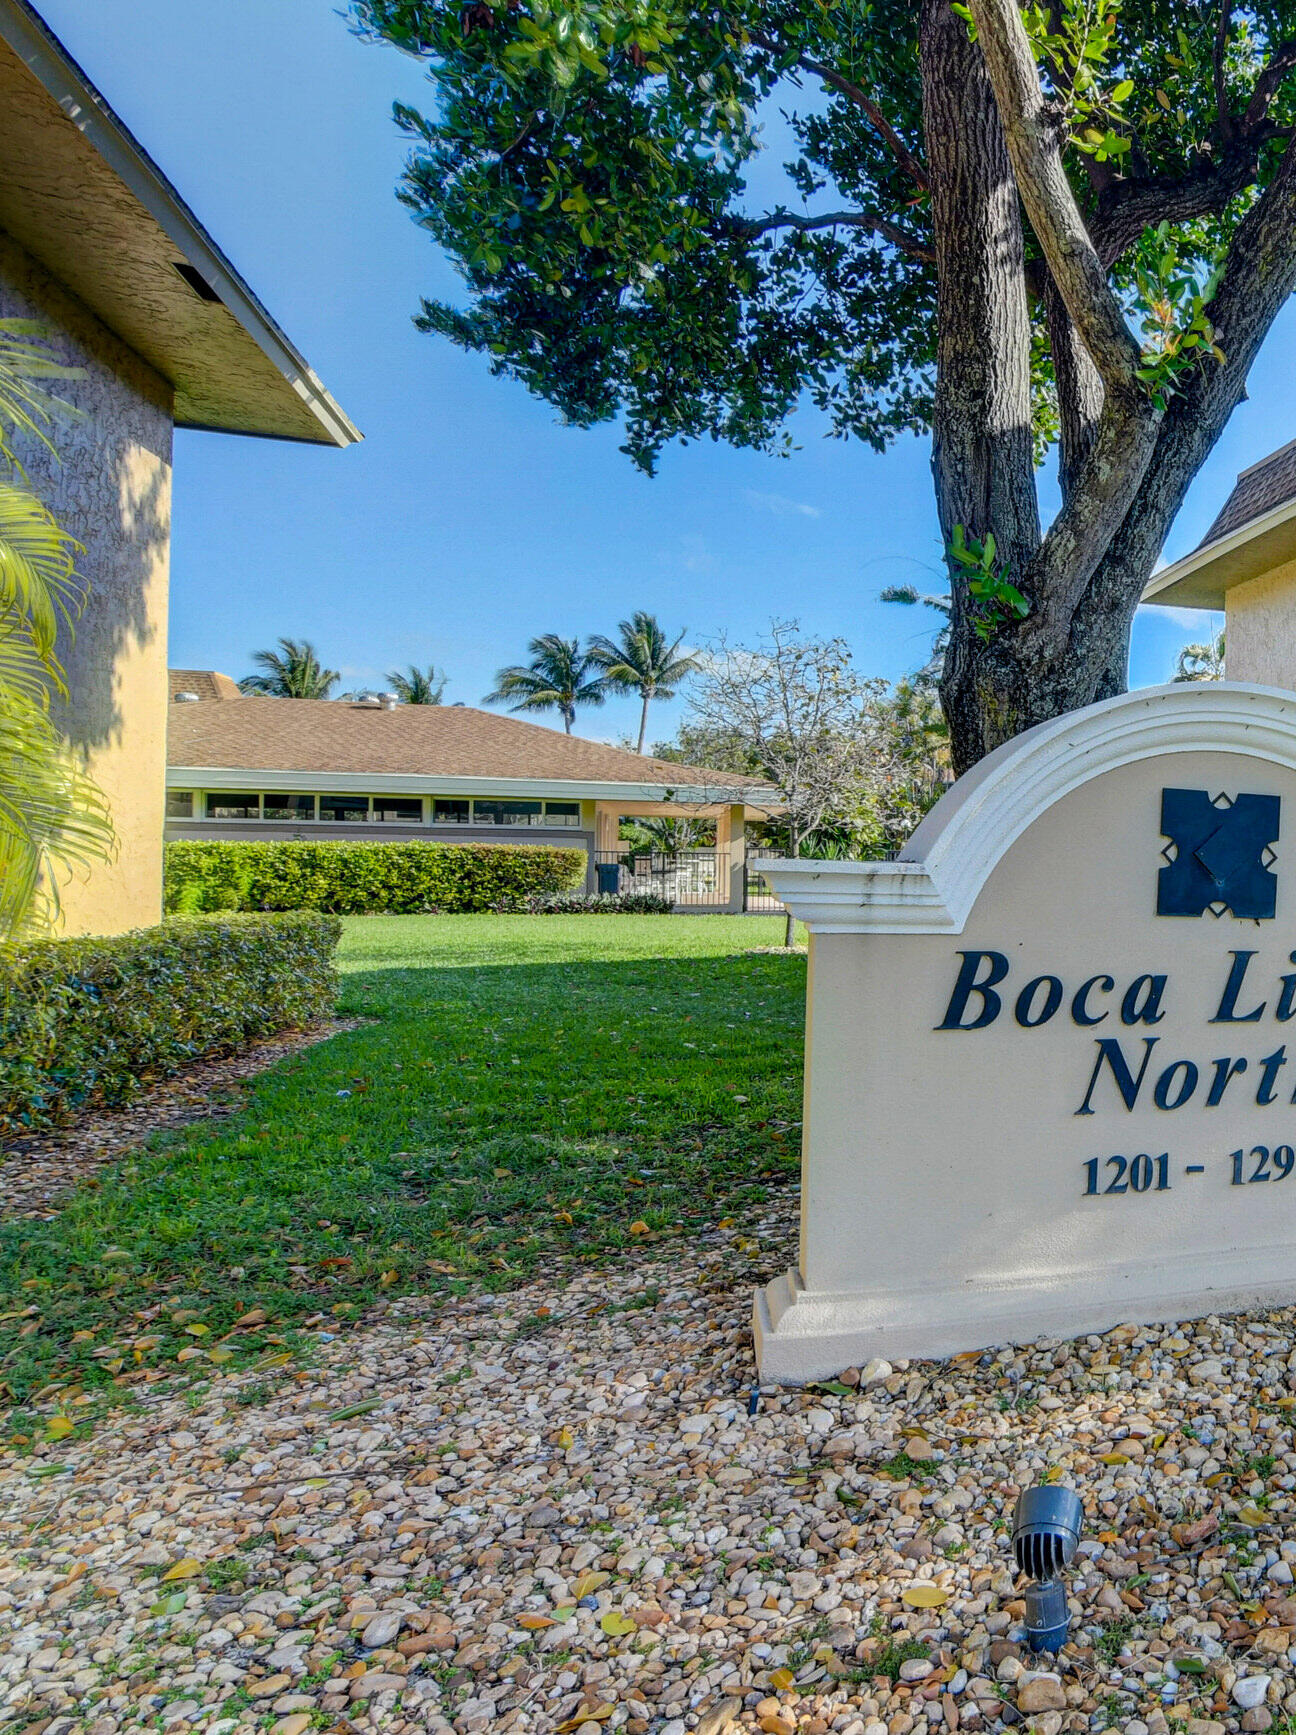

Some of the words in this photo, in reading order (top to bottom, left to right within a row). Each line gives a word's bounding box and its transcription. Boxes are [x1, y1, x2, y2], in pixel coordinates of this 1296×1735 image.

[931, 949, 1169, 1032] Boca
[1081, 1152, 1172, 1197] 1201
[1184, 1165, 1205, 1176] -
